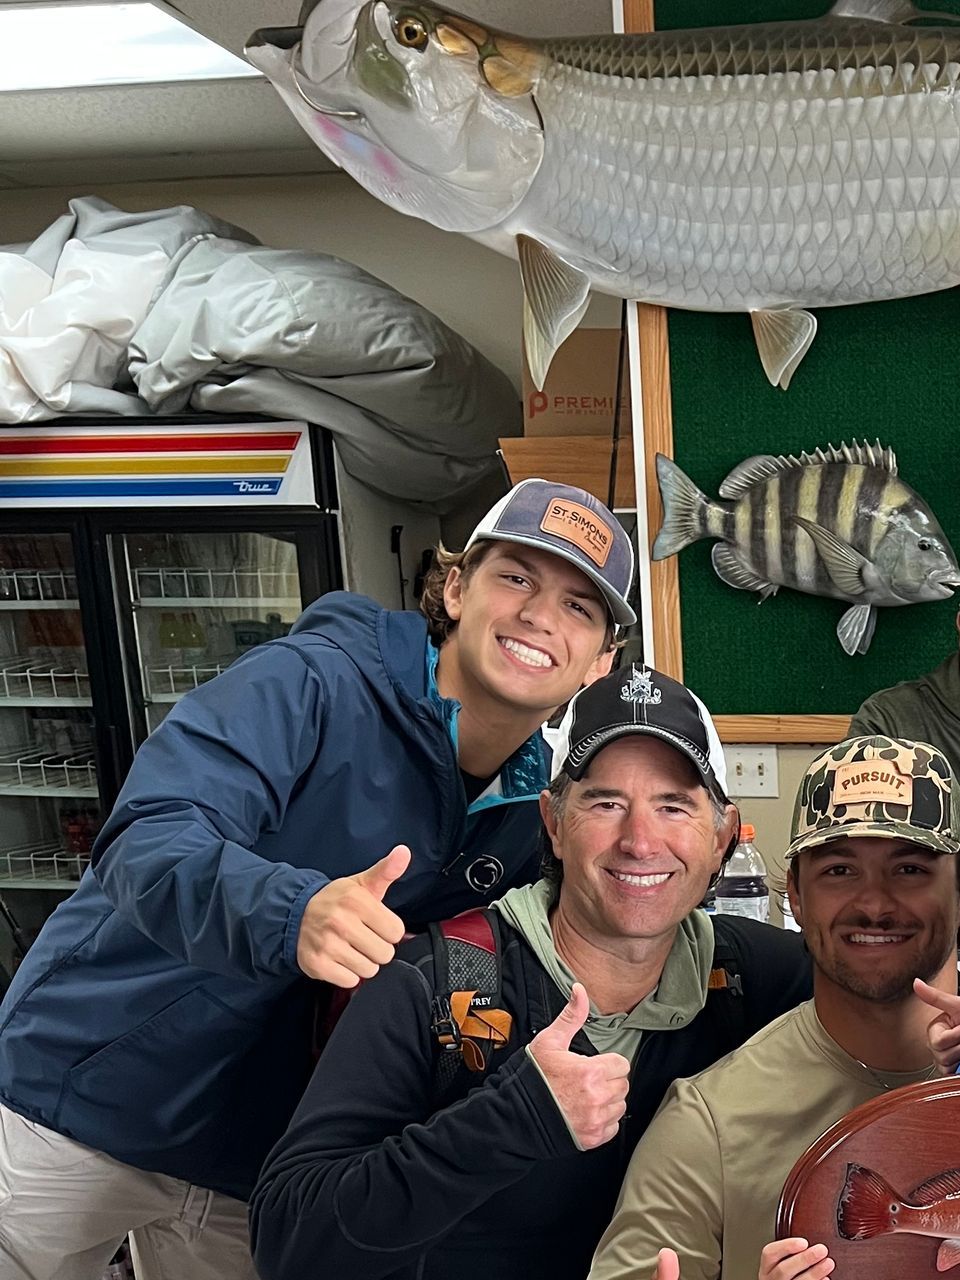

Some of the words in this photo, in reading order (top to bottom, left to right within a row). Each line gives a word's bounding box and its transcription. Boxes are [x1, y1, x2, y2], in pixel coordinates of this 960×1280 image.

[554, 396, 629, 408] PREMIE
[569, 511, 608, 545] SIMONS
[841, 771, 905, 790] PURSUIT
[470, 997, 492, 1006] PREY
